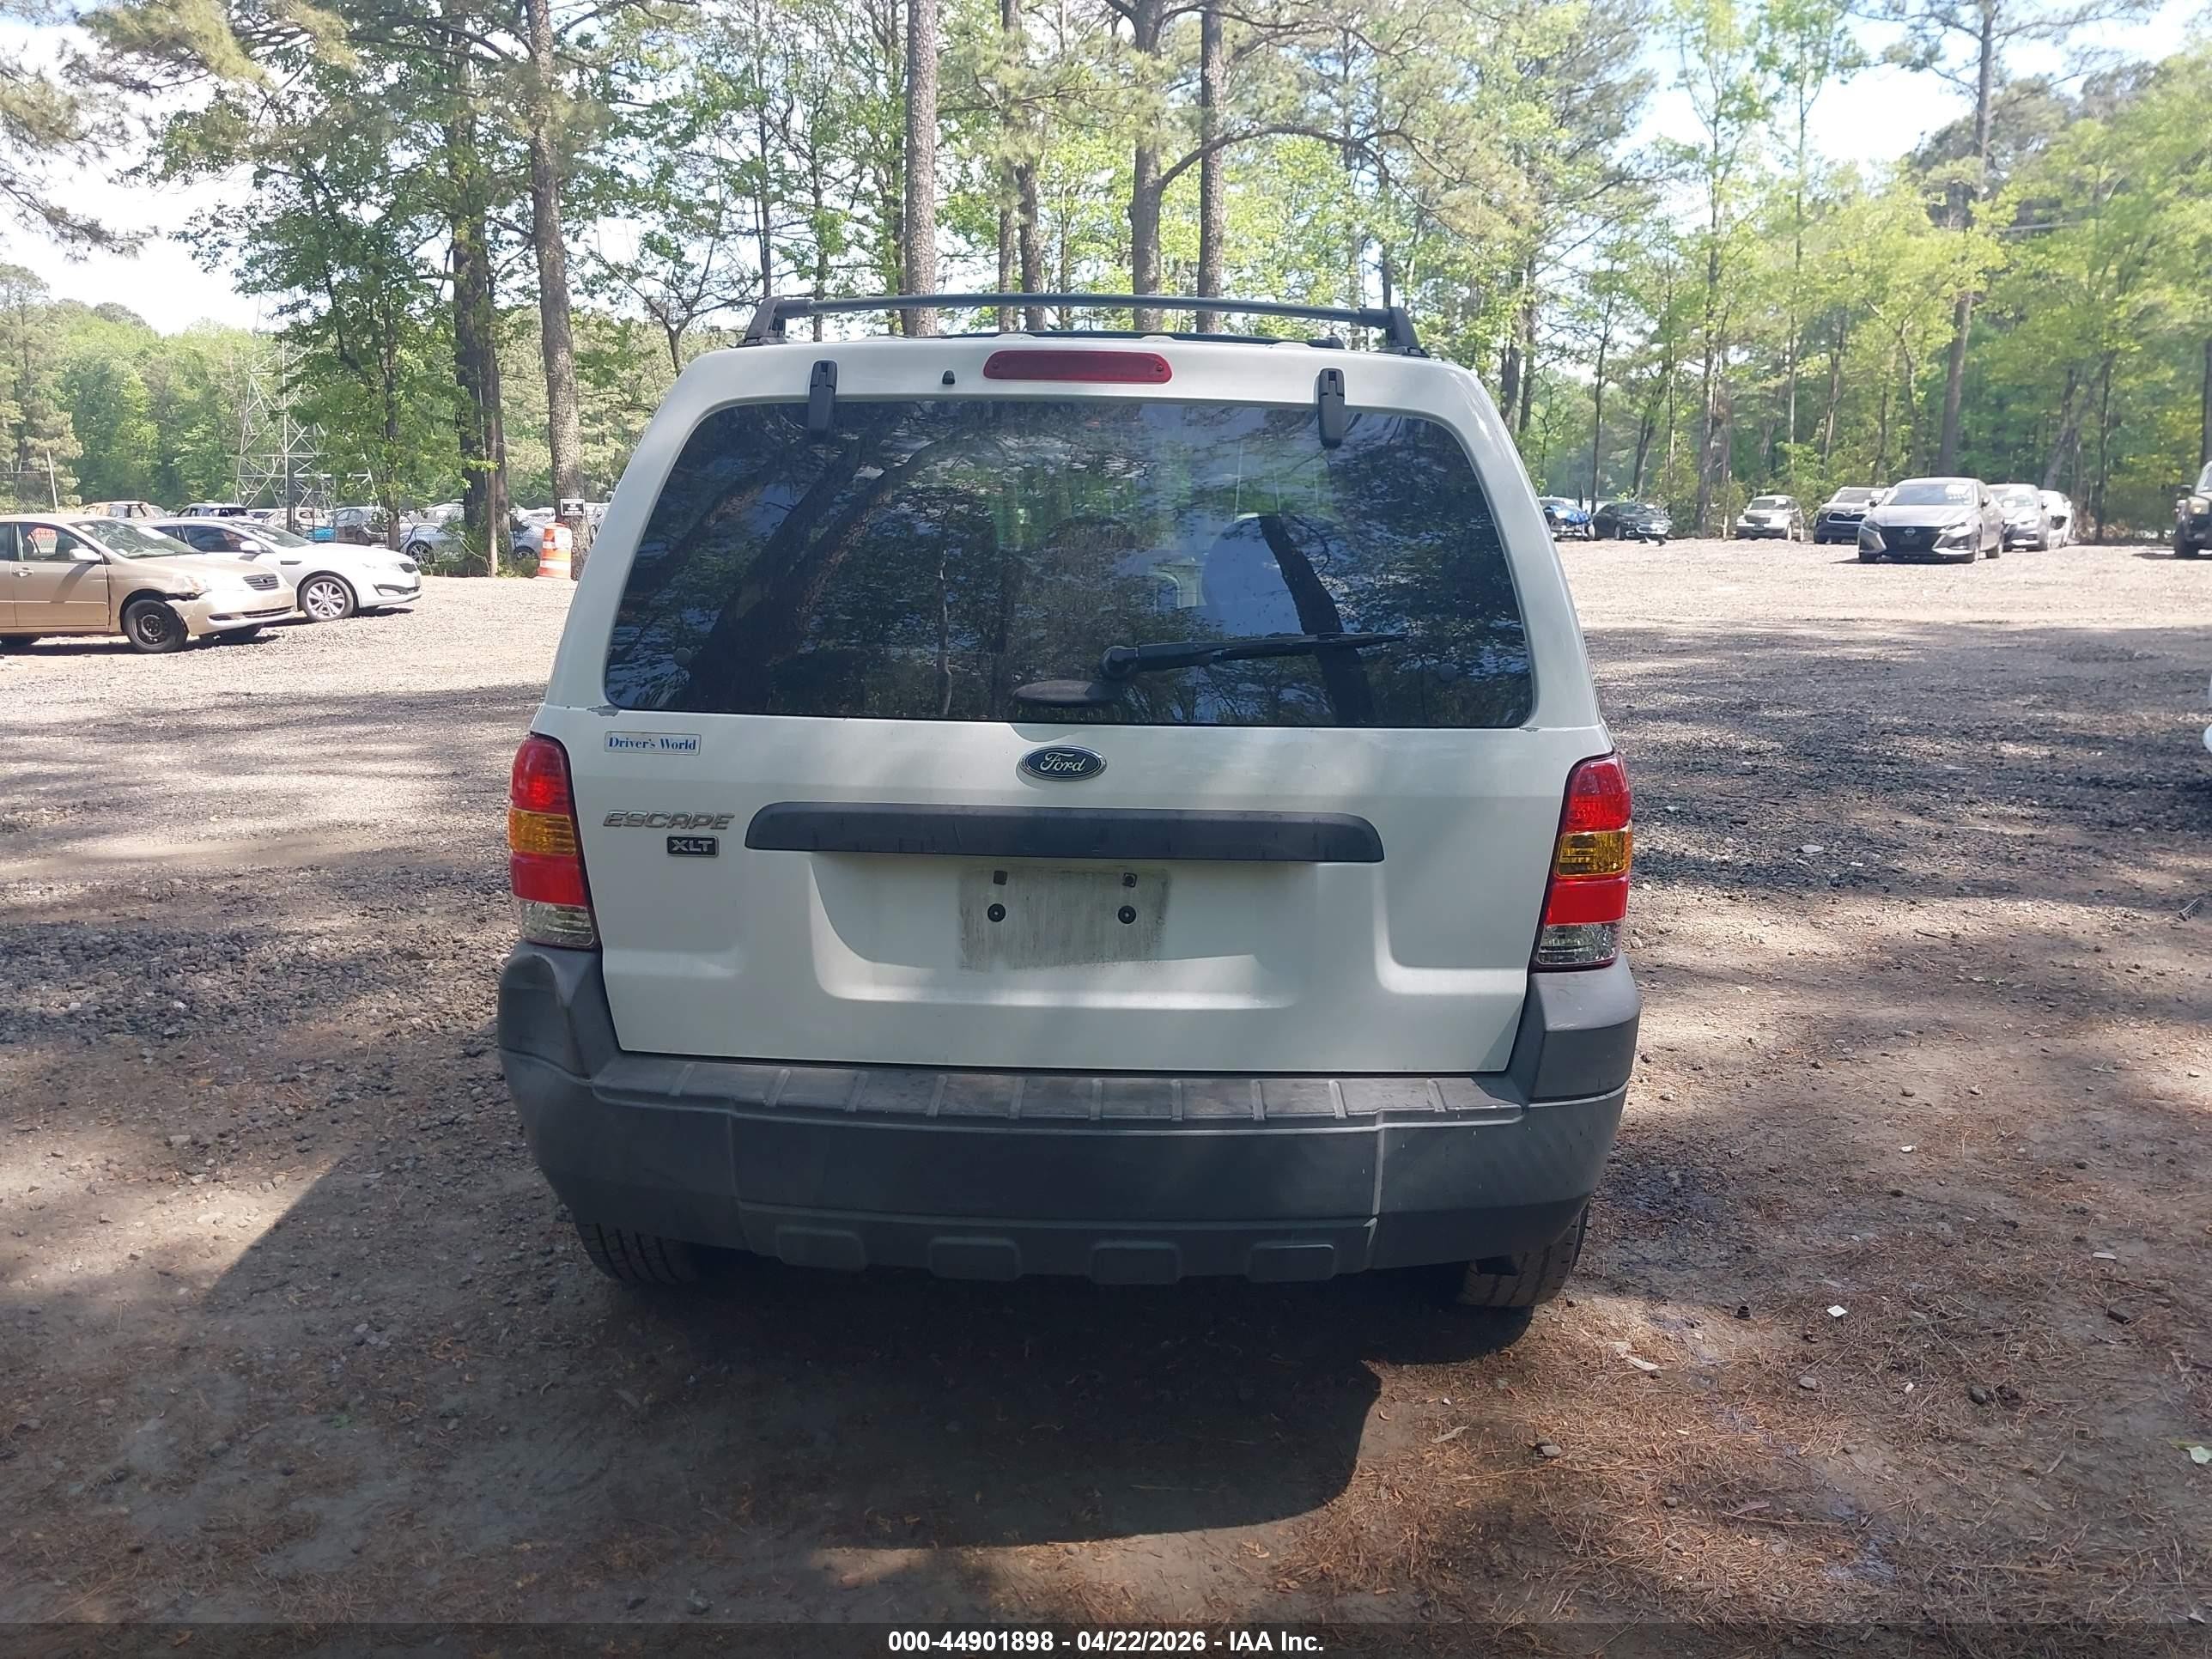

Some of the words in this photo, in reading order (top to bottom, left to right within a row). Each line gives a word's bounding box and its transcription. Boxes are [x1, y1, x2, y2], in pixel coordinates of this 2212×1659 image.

[609, 736, 656, 749] Driver's
[659, 738, 696, 750] World
[1040, 751, 1086, 771] Ford
[603, 810, 735, 830] ESCAPE
[671, 839, 713, 852] XLT
